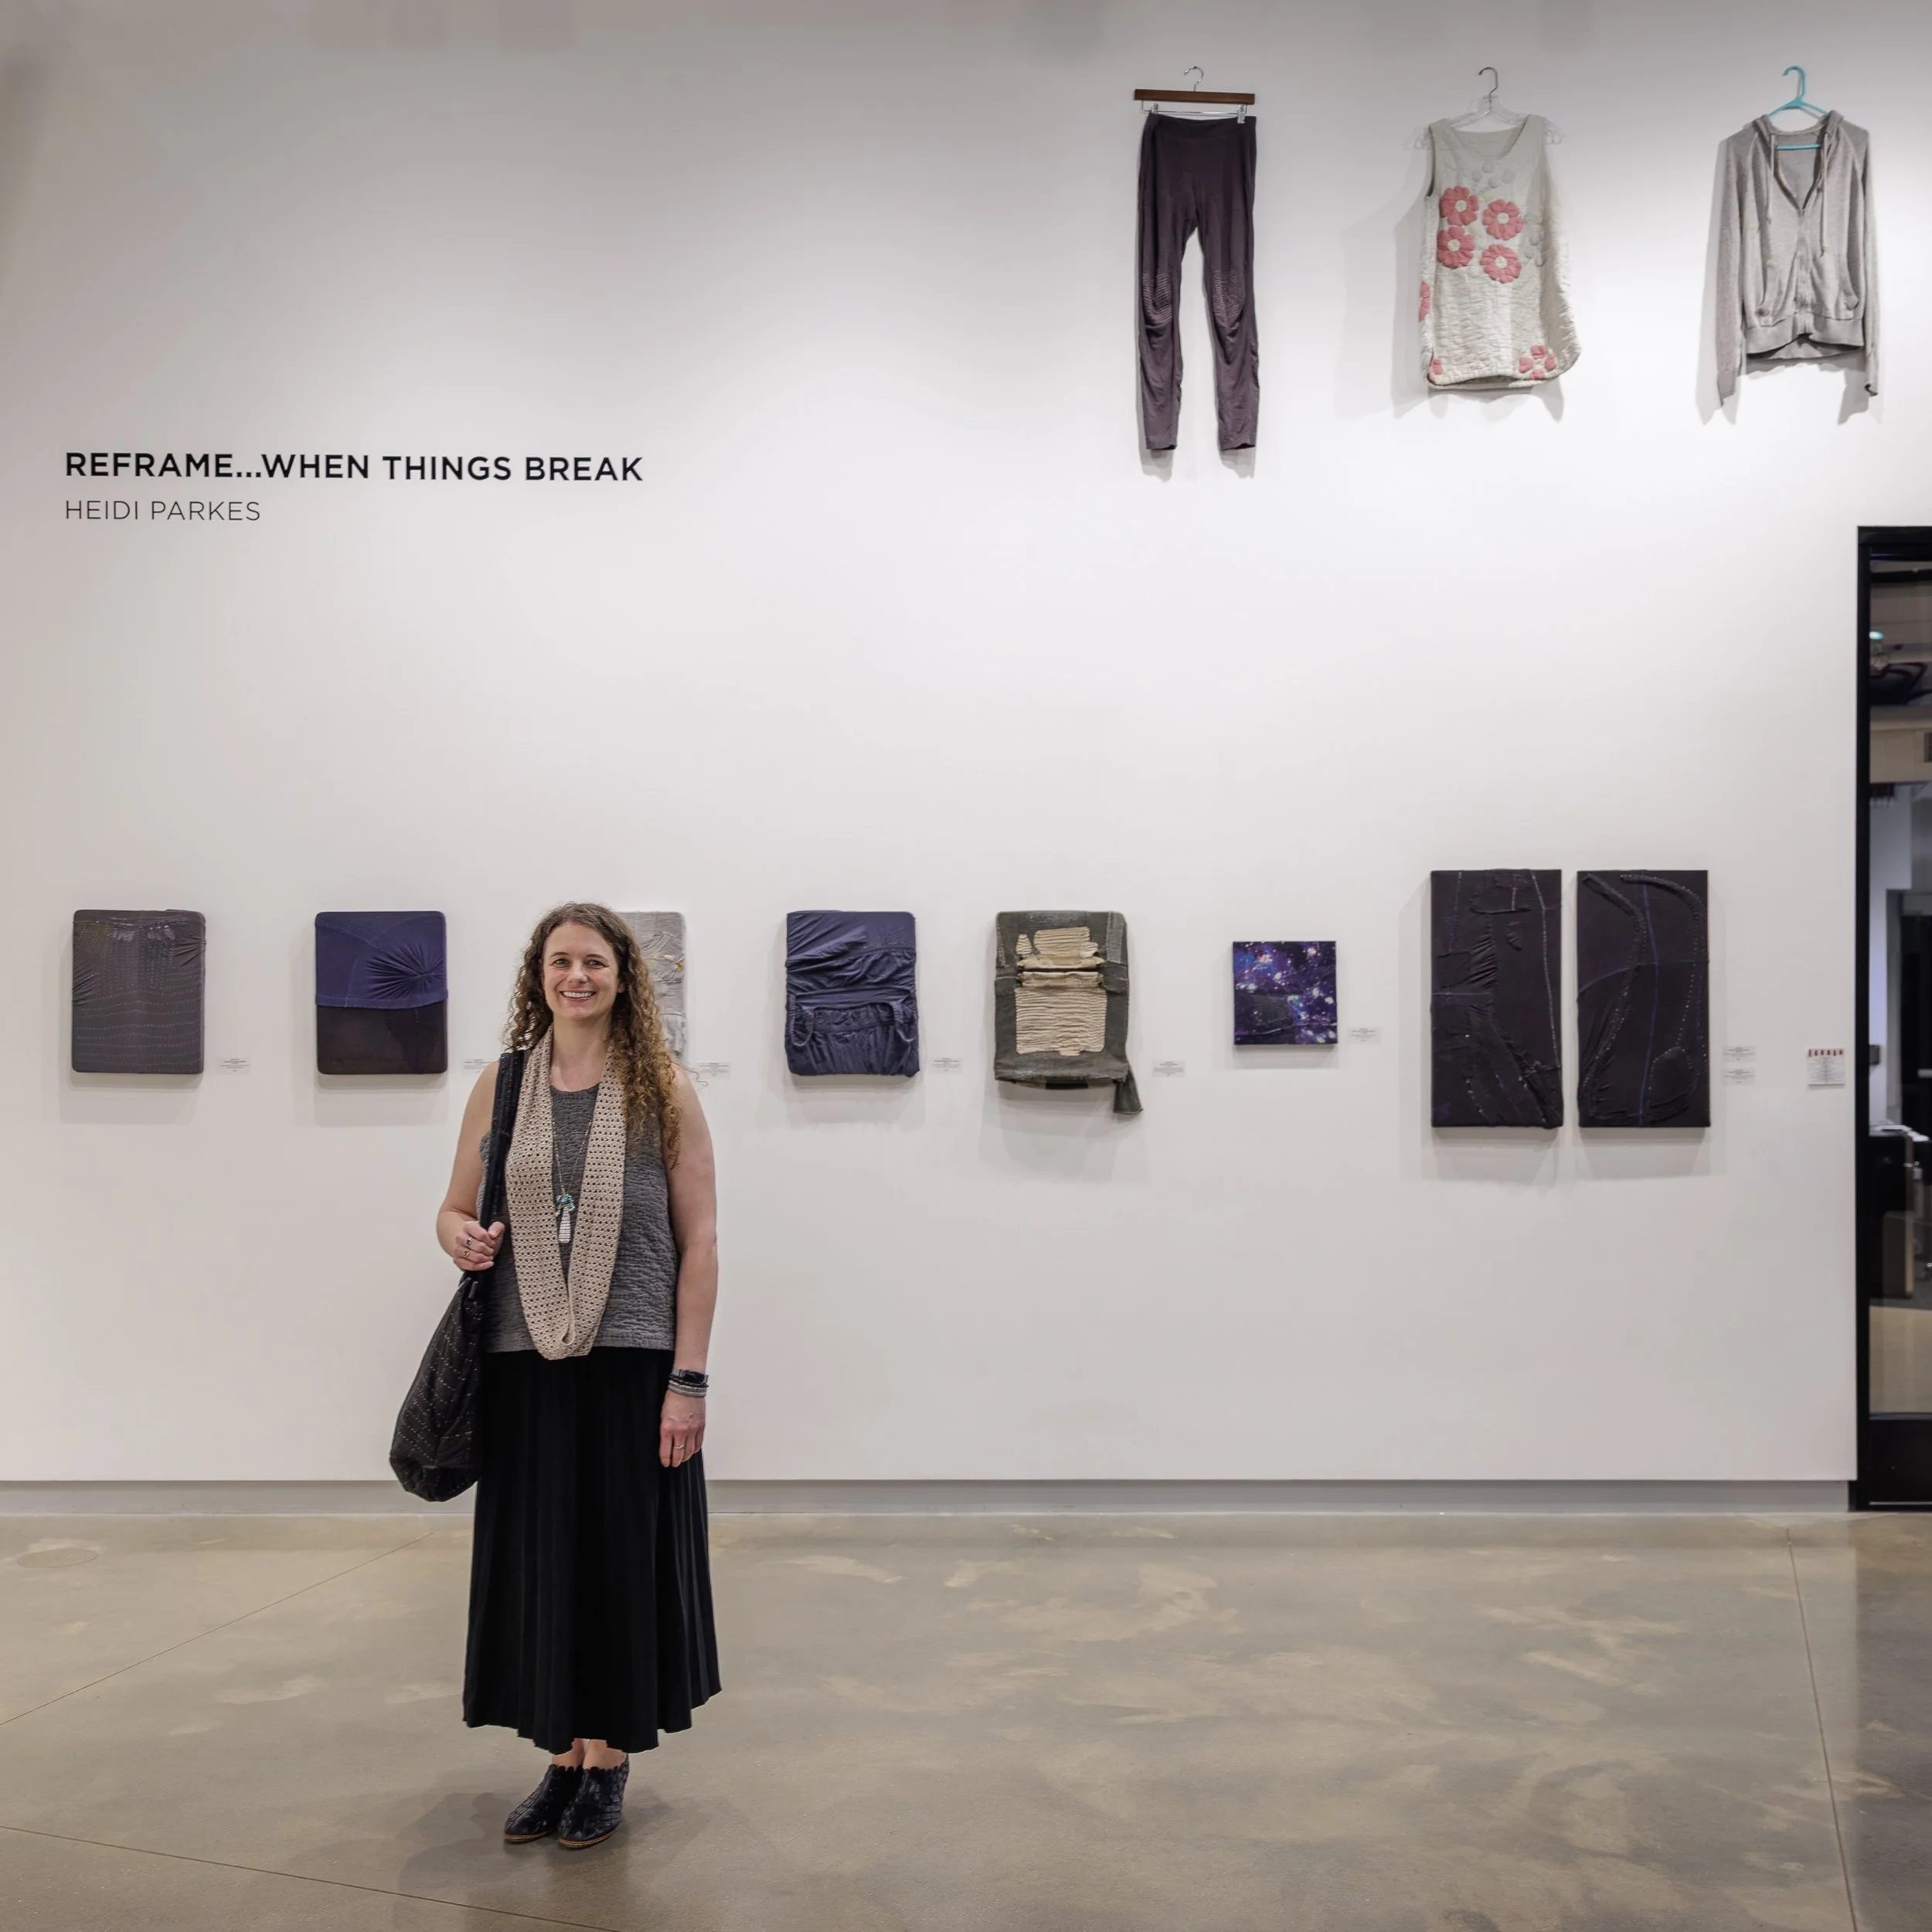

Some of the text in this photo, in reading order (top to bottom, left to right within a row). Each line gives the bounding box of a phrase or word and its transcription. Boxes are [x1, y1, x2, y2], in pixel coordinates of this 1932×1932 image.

[66, 451, 644, 481] REFRAME...WHEN THINGS BREAK
[65, 499, 260, 522] HEIDI PARKES
